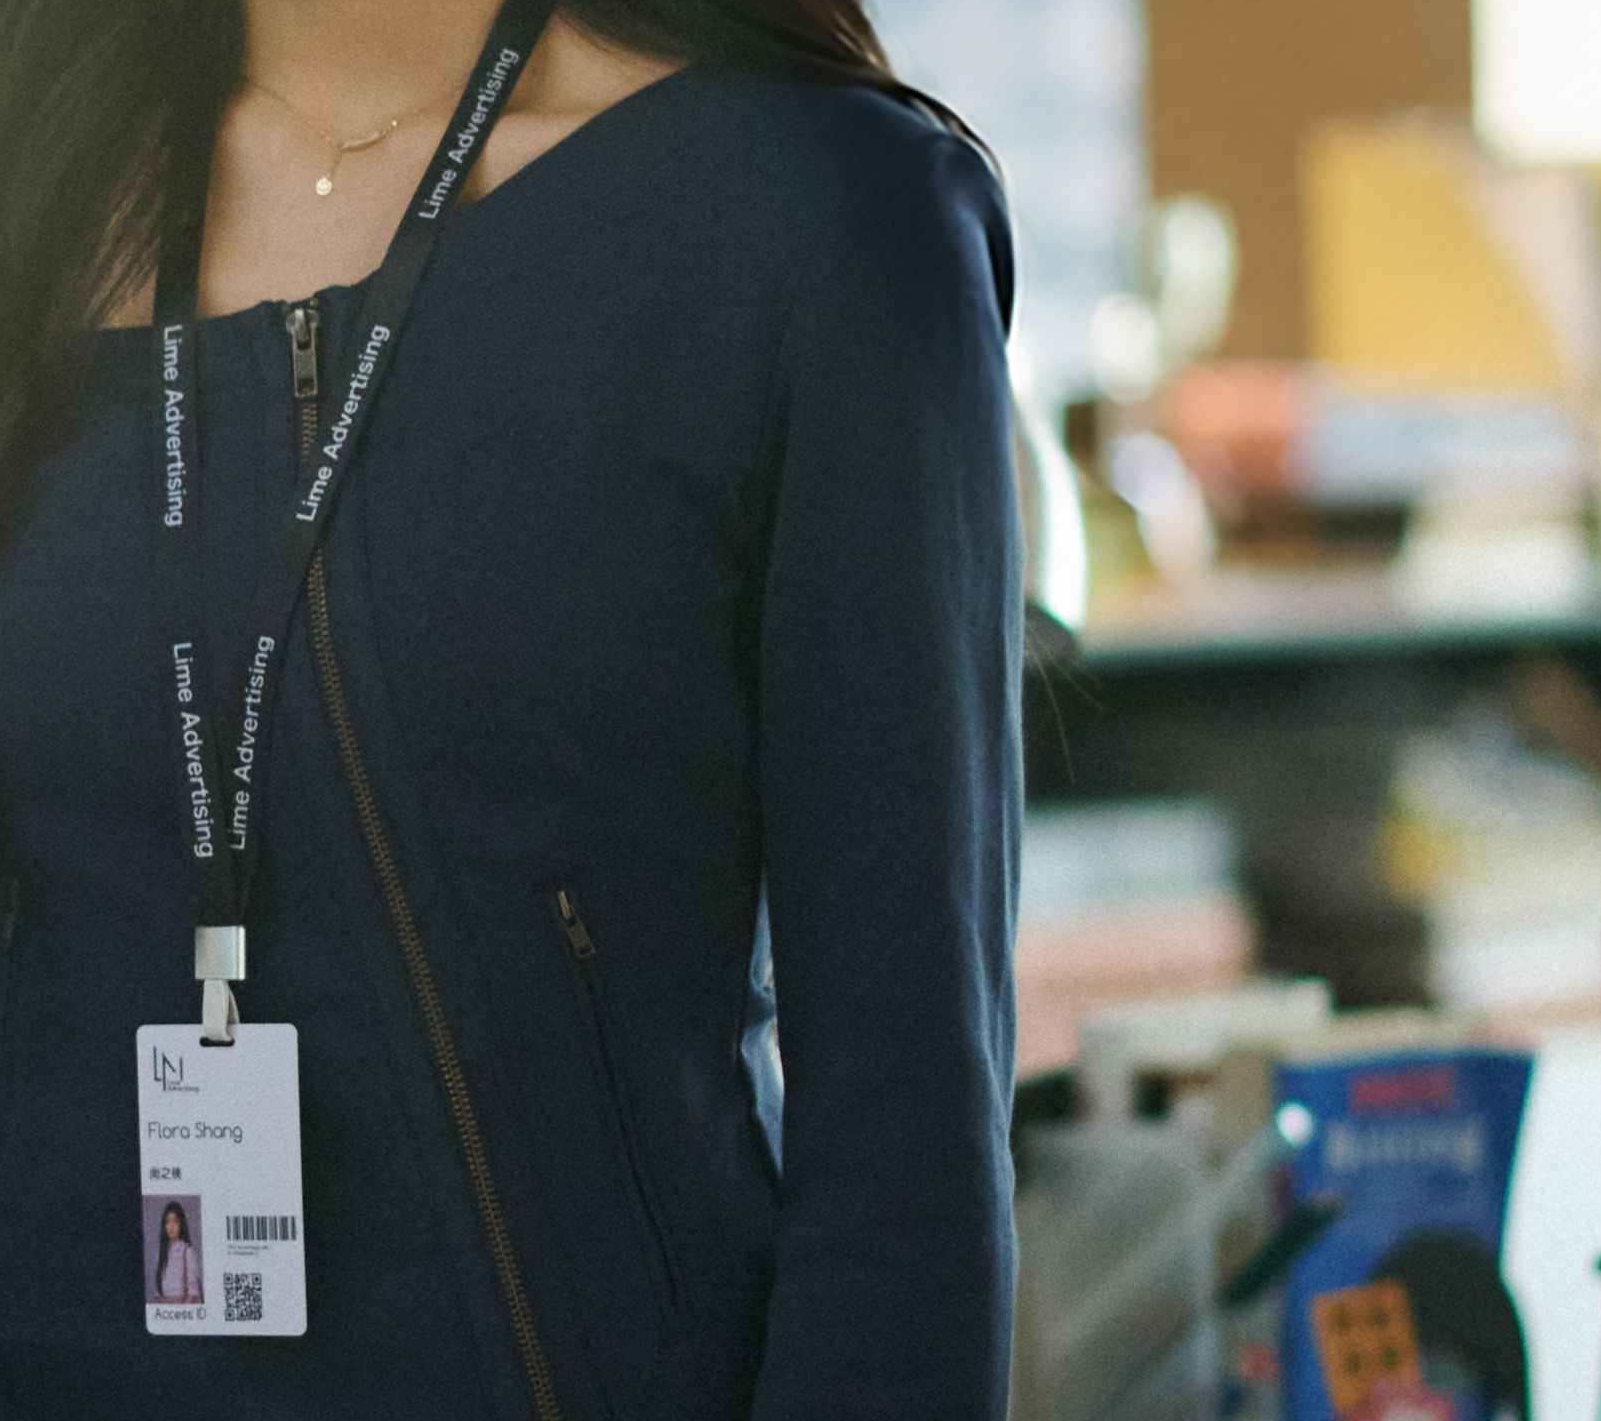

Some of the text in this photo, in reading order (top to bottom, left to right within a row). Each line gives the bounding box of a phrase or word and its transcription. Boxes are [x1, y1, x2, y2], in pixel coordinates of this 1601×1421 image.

[418, 47, 519, 220] Lime Advertising
[163, 324, 185, 527] Lime Advertising
[296, 324, 391, 523] Lime Advertising
[172, 642, 214, 858] Lime Advertising
[229, 635, 275, 850] Lime Advertising
[148, 1121, 243, 1143] Flora Shang
[154, 1307, 194, 1320] Access
